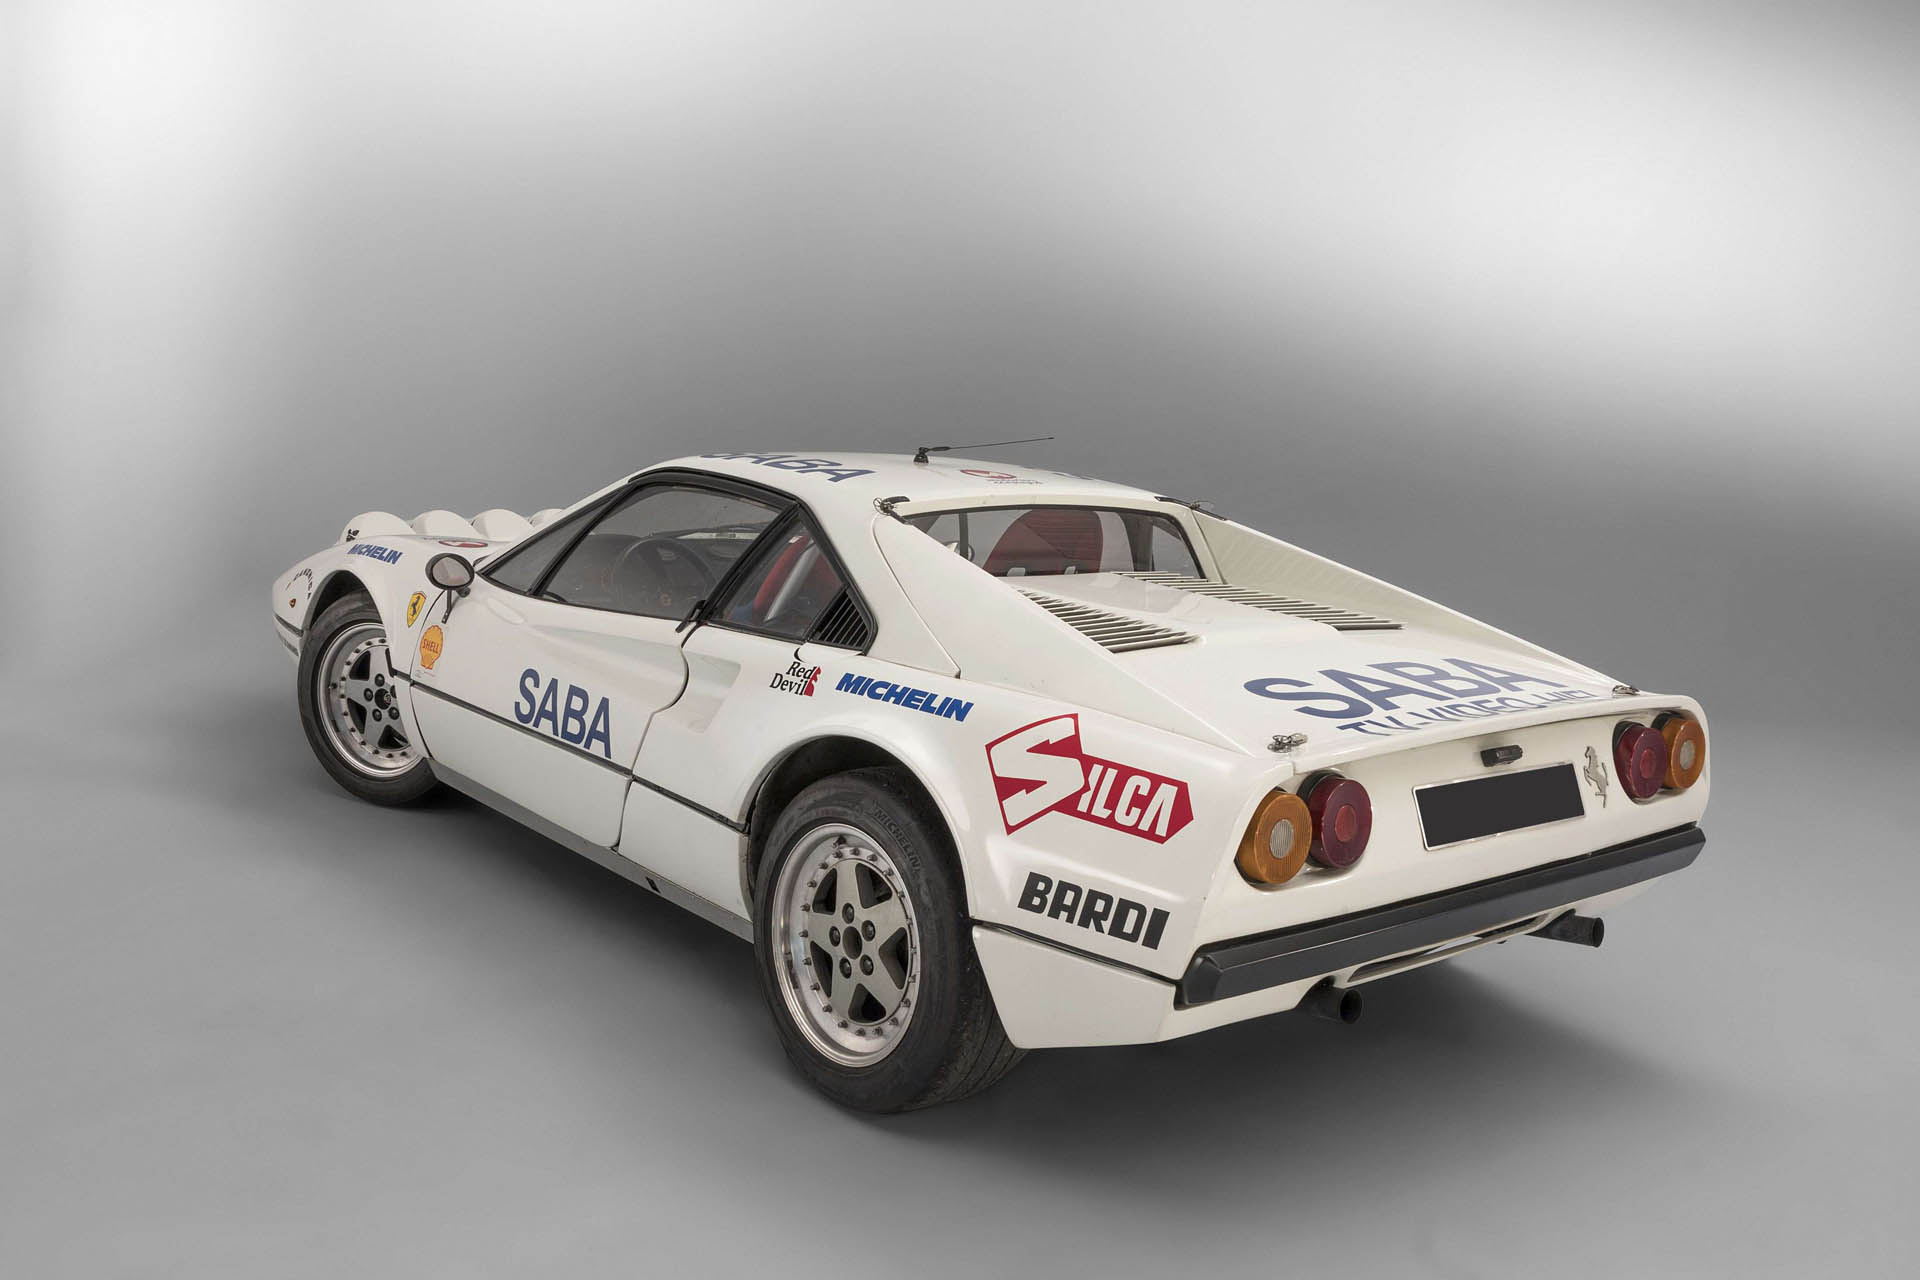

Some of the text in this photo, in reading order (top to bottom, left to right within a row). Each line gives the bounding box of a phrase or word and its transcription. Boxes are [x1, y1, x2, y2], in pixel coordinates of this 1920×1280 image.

[347, 544, 404, 565] MICHELIN
[422, 639, 440, 654] SHELL
[786, 661, 816, 680] Red
[769, 672, 808, 696] Devil
[835, 672, 974, 722] MICHELIN
[1243, 659, 1567, 719] SABA
[514, 668, 611, 760] SABA
[986, 713, 1185, 842] SILCA
[873, 806, 921, 873] MICHELIN
[1017, 872, 1171, 951] BARDI
